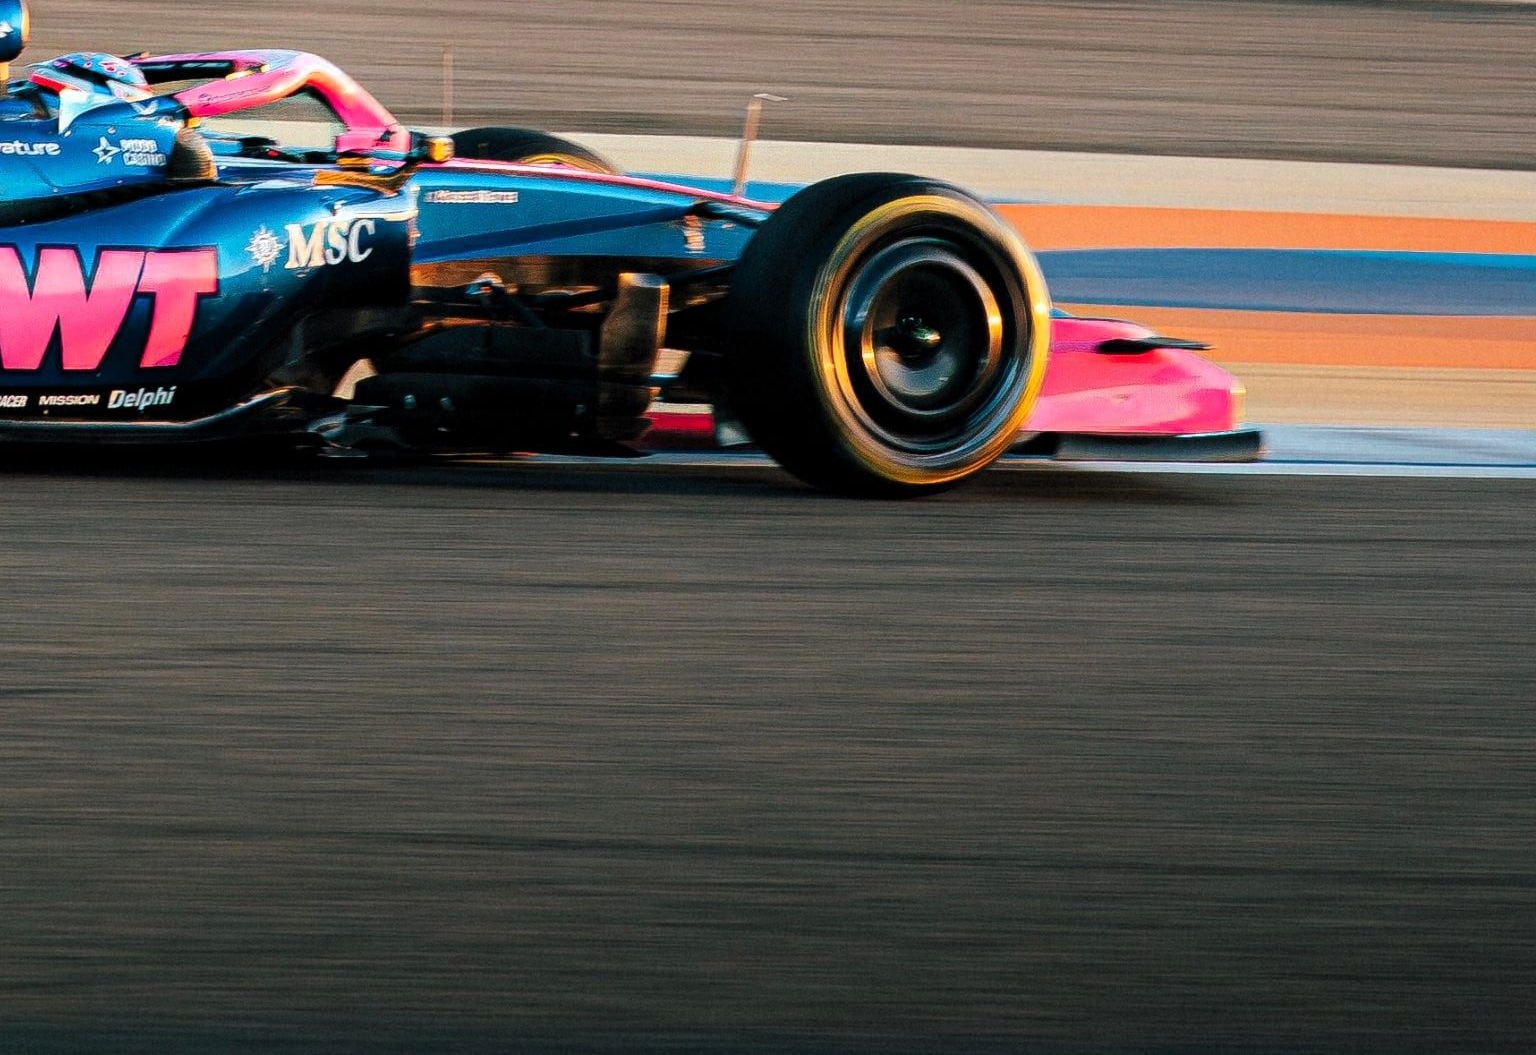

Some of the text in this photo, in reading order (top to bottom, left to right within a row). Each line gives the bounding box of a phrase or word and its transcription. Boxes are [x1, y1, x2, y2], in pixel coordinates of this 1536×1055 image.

[284, 219, 376, 269] MSC
[38, 395, 100, 406] MISSION
[107, 386, 177, 410] Delphi
